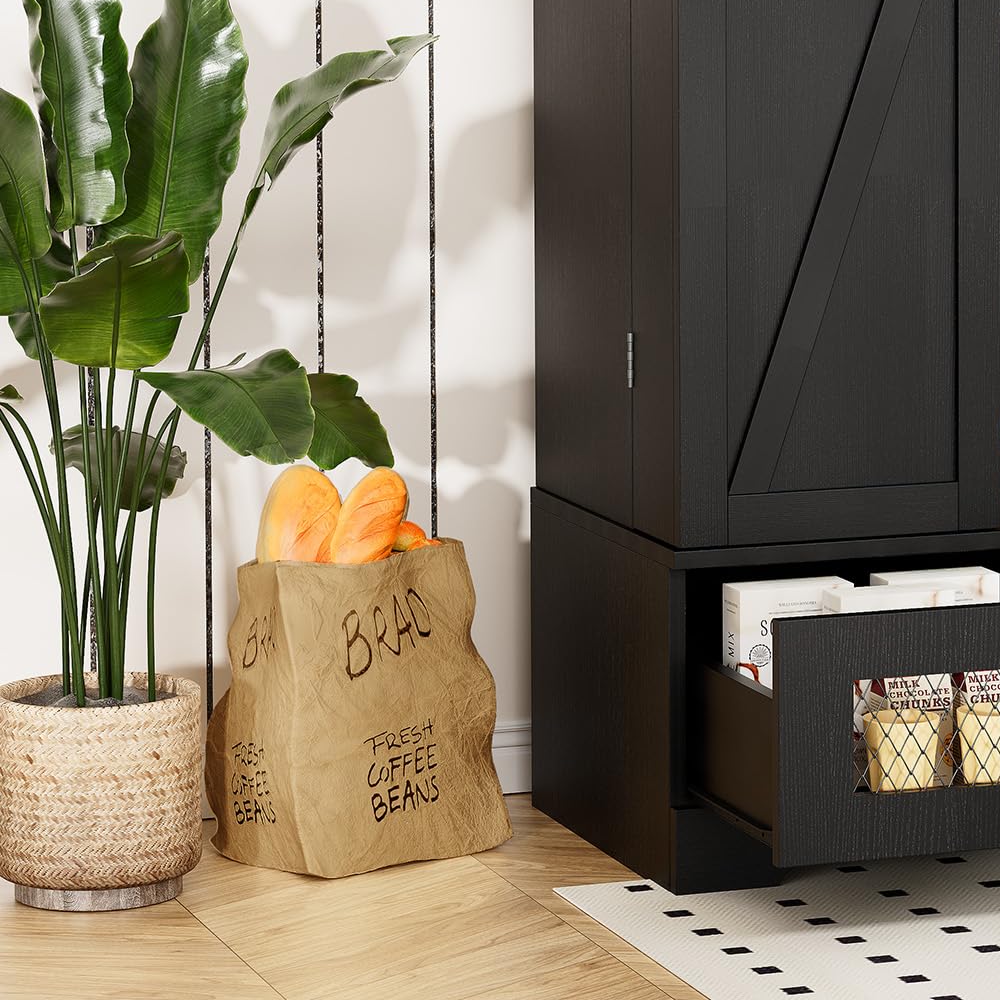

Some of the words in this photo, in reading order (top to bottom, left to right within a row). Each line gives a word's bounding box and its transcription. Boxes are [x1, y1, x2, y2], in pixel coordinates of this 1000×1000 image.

[888, 680, 920, 689] MILK
[968, 674, 999, 683] MILK
[890, 697, 950, 710] CHUNKS
[363, 718, 433, 756] FRESH
[368, 743, 438, 788] COFFEE
[234, 799, 276, 825] BEANS
[371, 775, 439, 823] BEANS
